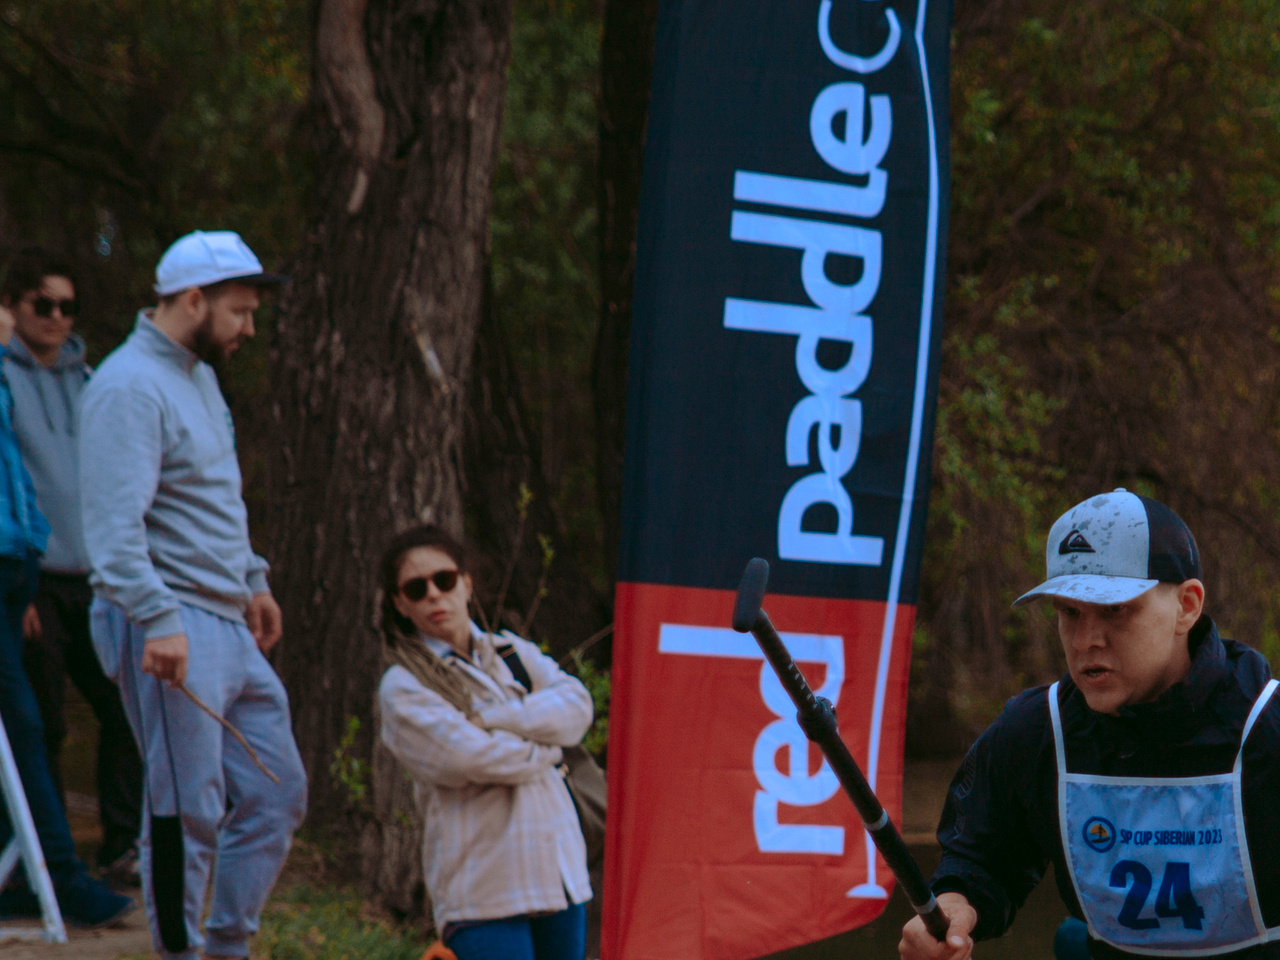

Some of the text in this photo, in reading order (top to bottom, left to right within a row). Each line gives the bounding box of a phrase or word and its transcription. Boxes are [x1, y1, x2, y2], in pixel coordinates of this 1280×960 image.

[723, 81, 892, 566] paddle
[658, 623, 846, 856] red
[1109, 860, 1206, 931] 24
[1134, 831, 1152, 846] CUP
[1154, 831, 1196, 846] SIBERIAN
[1198, 829, 1223, 846] 2023
